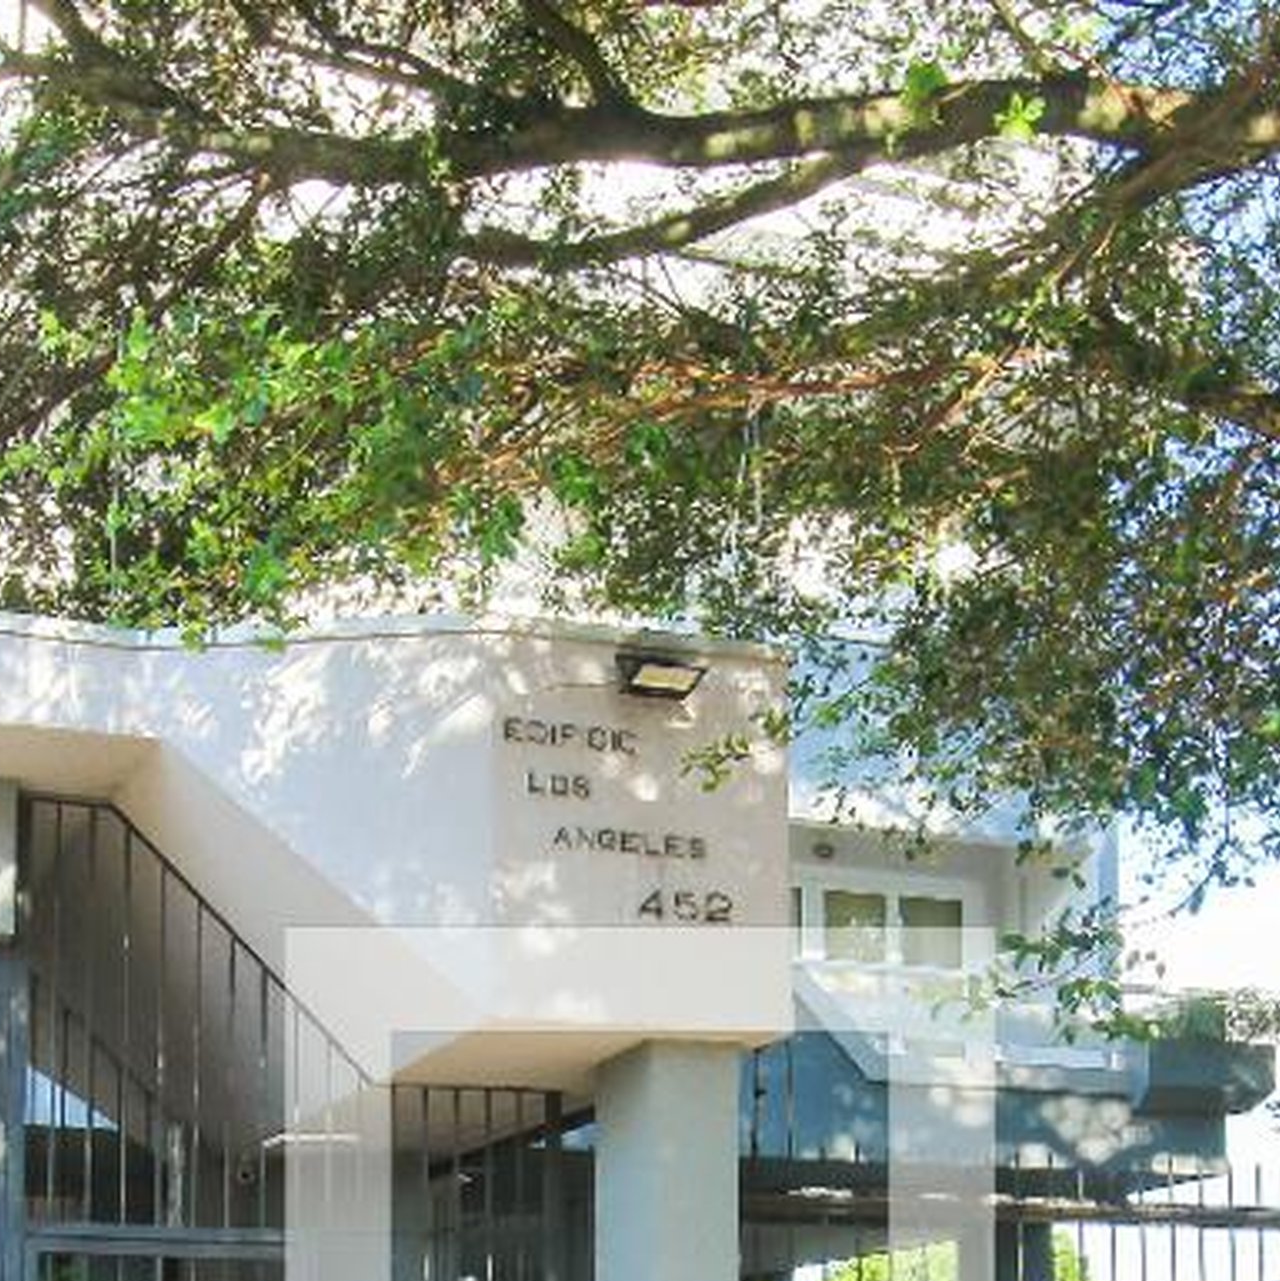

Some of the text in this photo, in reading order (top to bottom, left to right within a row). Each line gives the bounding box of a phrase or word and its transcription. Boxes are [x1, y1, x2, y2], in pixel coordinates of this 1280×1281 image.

[527, 772, 590, 800] LOS
[554, 826, 706, 859] ANGELES
[639, 888, 733, 922] 452
